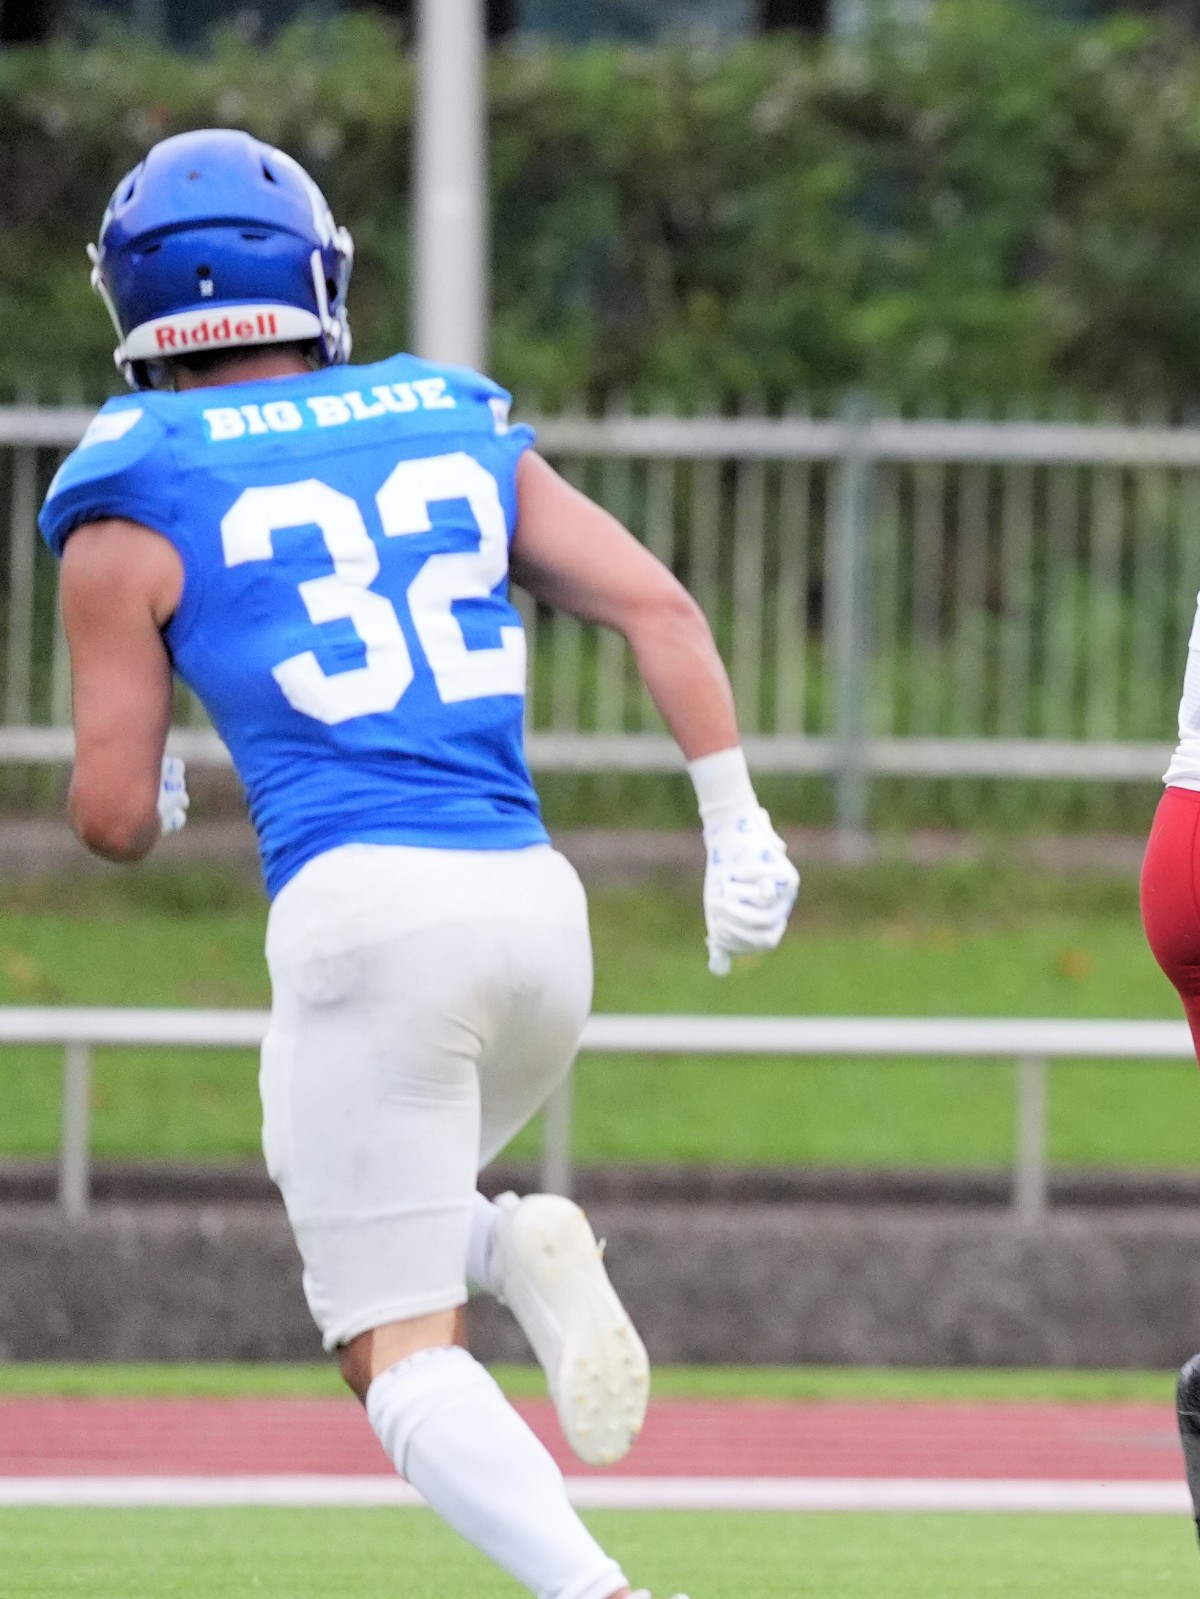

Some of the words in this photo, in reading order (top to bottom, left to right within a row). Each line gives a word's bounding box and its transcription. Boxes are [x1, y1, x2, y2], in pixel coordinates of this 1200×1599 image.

[155, 312, 277, 350] Riddell
[203, 400, 303, 441] BIG
[307, 377, 456, 427] BLUE
[222, 451, 527, 725] 32
